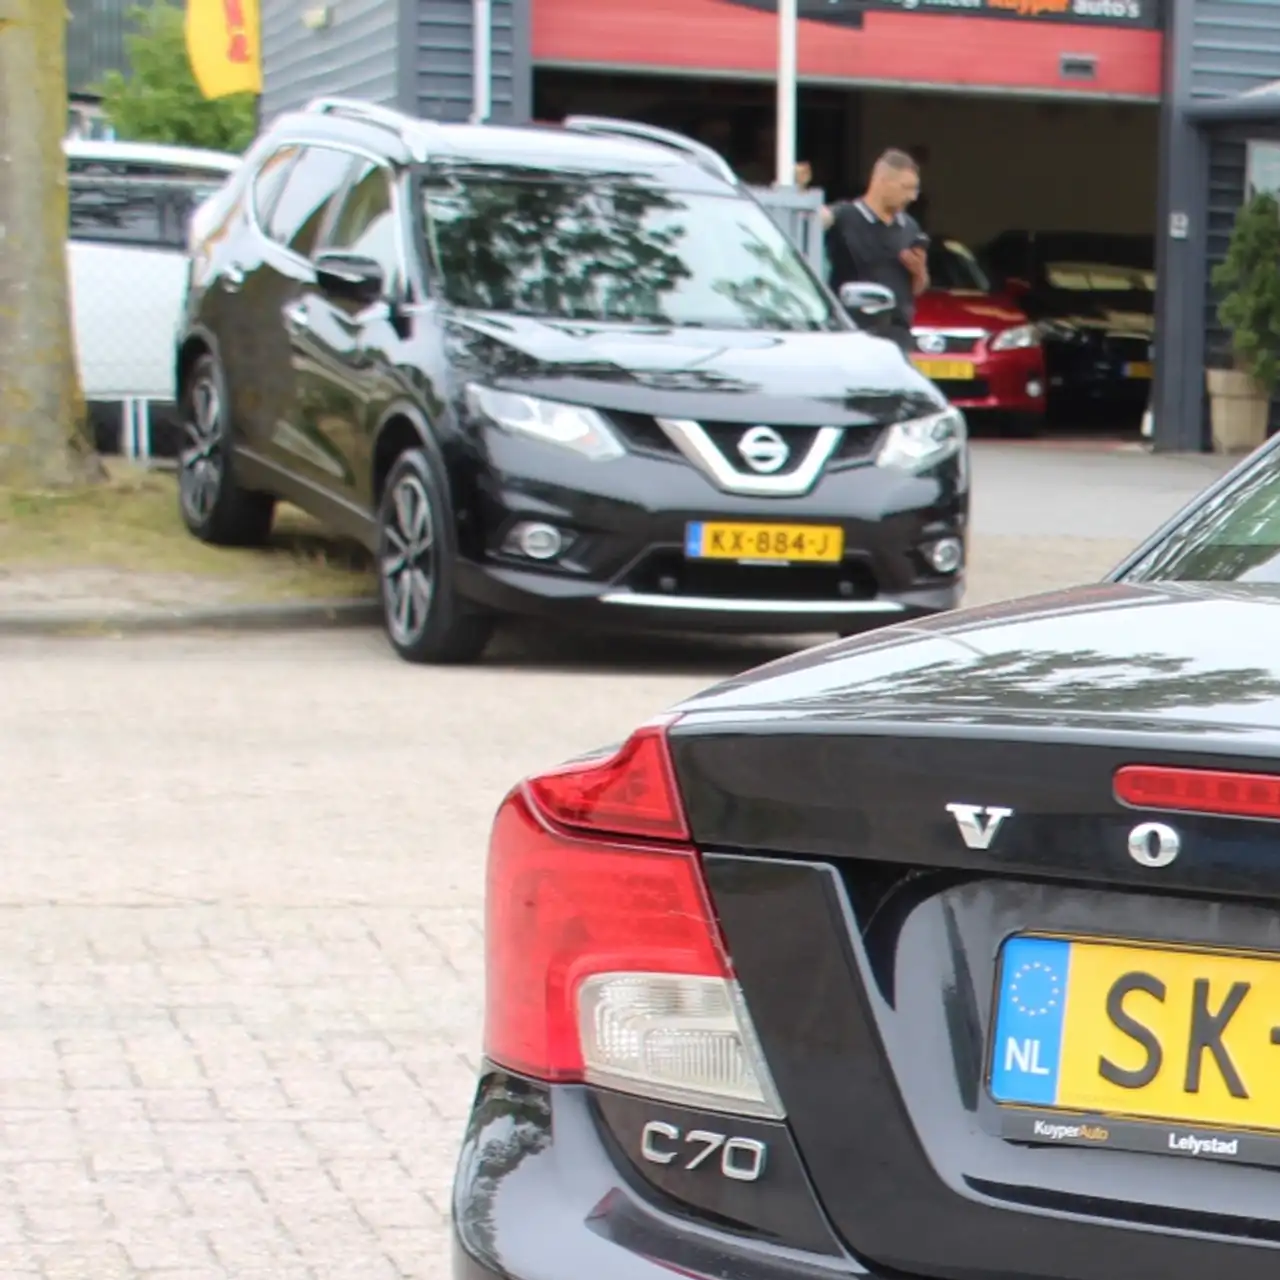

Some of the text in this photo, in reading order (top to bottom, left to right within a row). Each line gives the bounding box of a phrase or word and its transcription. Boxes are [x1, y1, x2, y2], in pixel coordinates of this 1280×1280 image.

[711, 528, 830, 557] KX-884-J
[1004, 1036, 1050, 1075] NL
[641, 1120, 767, 1182] C70
[1033, 1120, 1109, 1141] KuyperAuto
[1168, 1132, 1239, 1155] Lelystad
